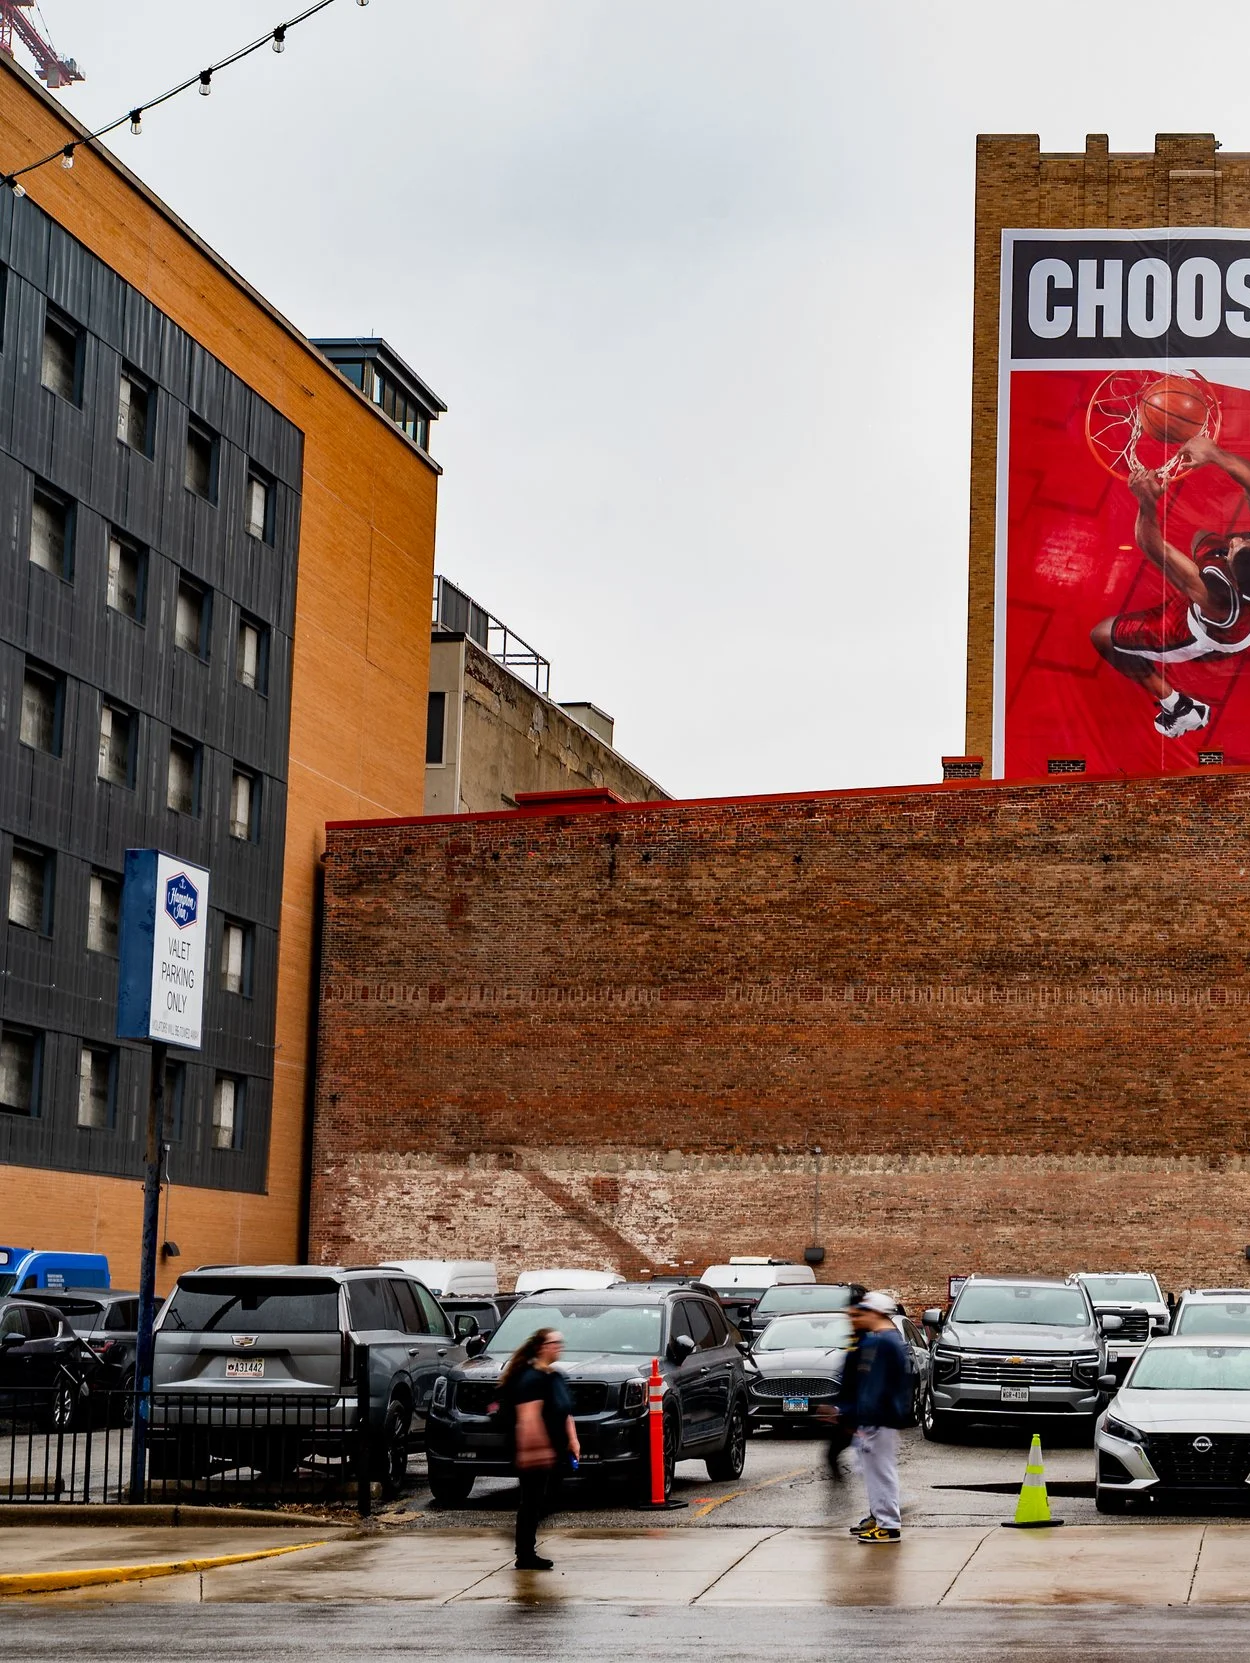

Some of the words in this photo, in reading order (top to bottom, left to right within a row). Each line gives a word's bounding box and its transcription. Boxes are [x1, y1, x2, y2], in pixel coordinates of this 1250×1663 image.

[168, 887, 196, 910] Hampton
[173, 904, 189, 921] Inn
[168, 936, 191, 961] VALET
[161, 961, 195, 989] PARKING
[166, 990, 188, 1014] ONLY
[235, 1362, 263, 1373] A31442
